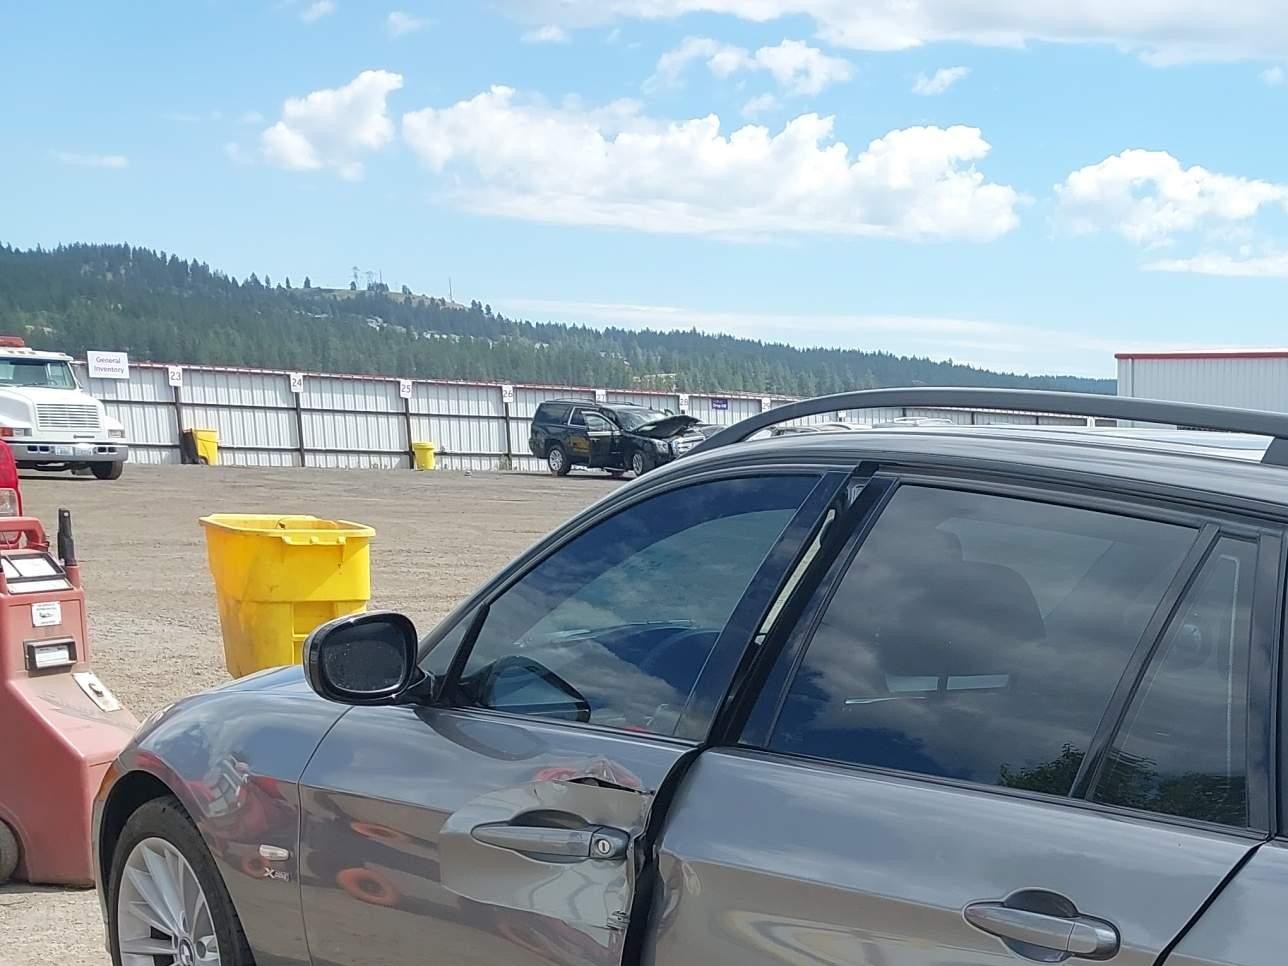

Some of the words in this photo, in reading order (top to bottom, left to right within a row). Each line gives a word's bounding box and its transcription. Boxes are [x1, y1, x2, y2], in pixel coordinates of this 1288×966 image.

[95, 356, 121, 364] General
[94, 366, 124, 374] Inventory
[169, 371, 182, 381] 23
[291, 378, 302, 387] 24
[401, 384, 411, 393] 25
[503, 389, 513, 398] 26
